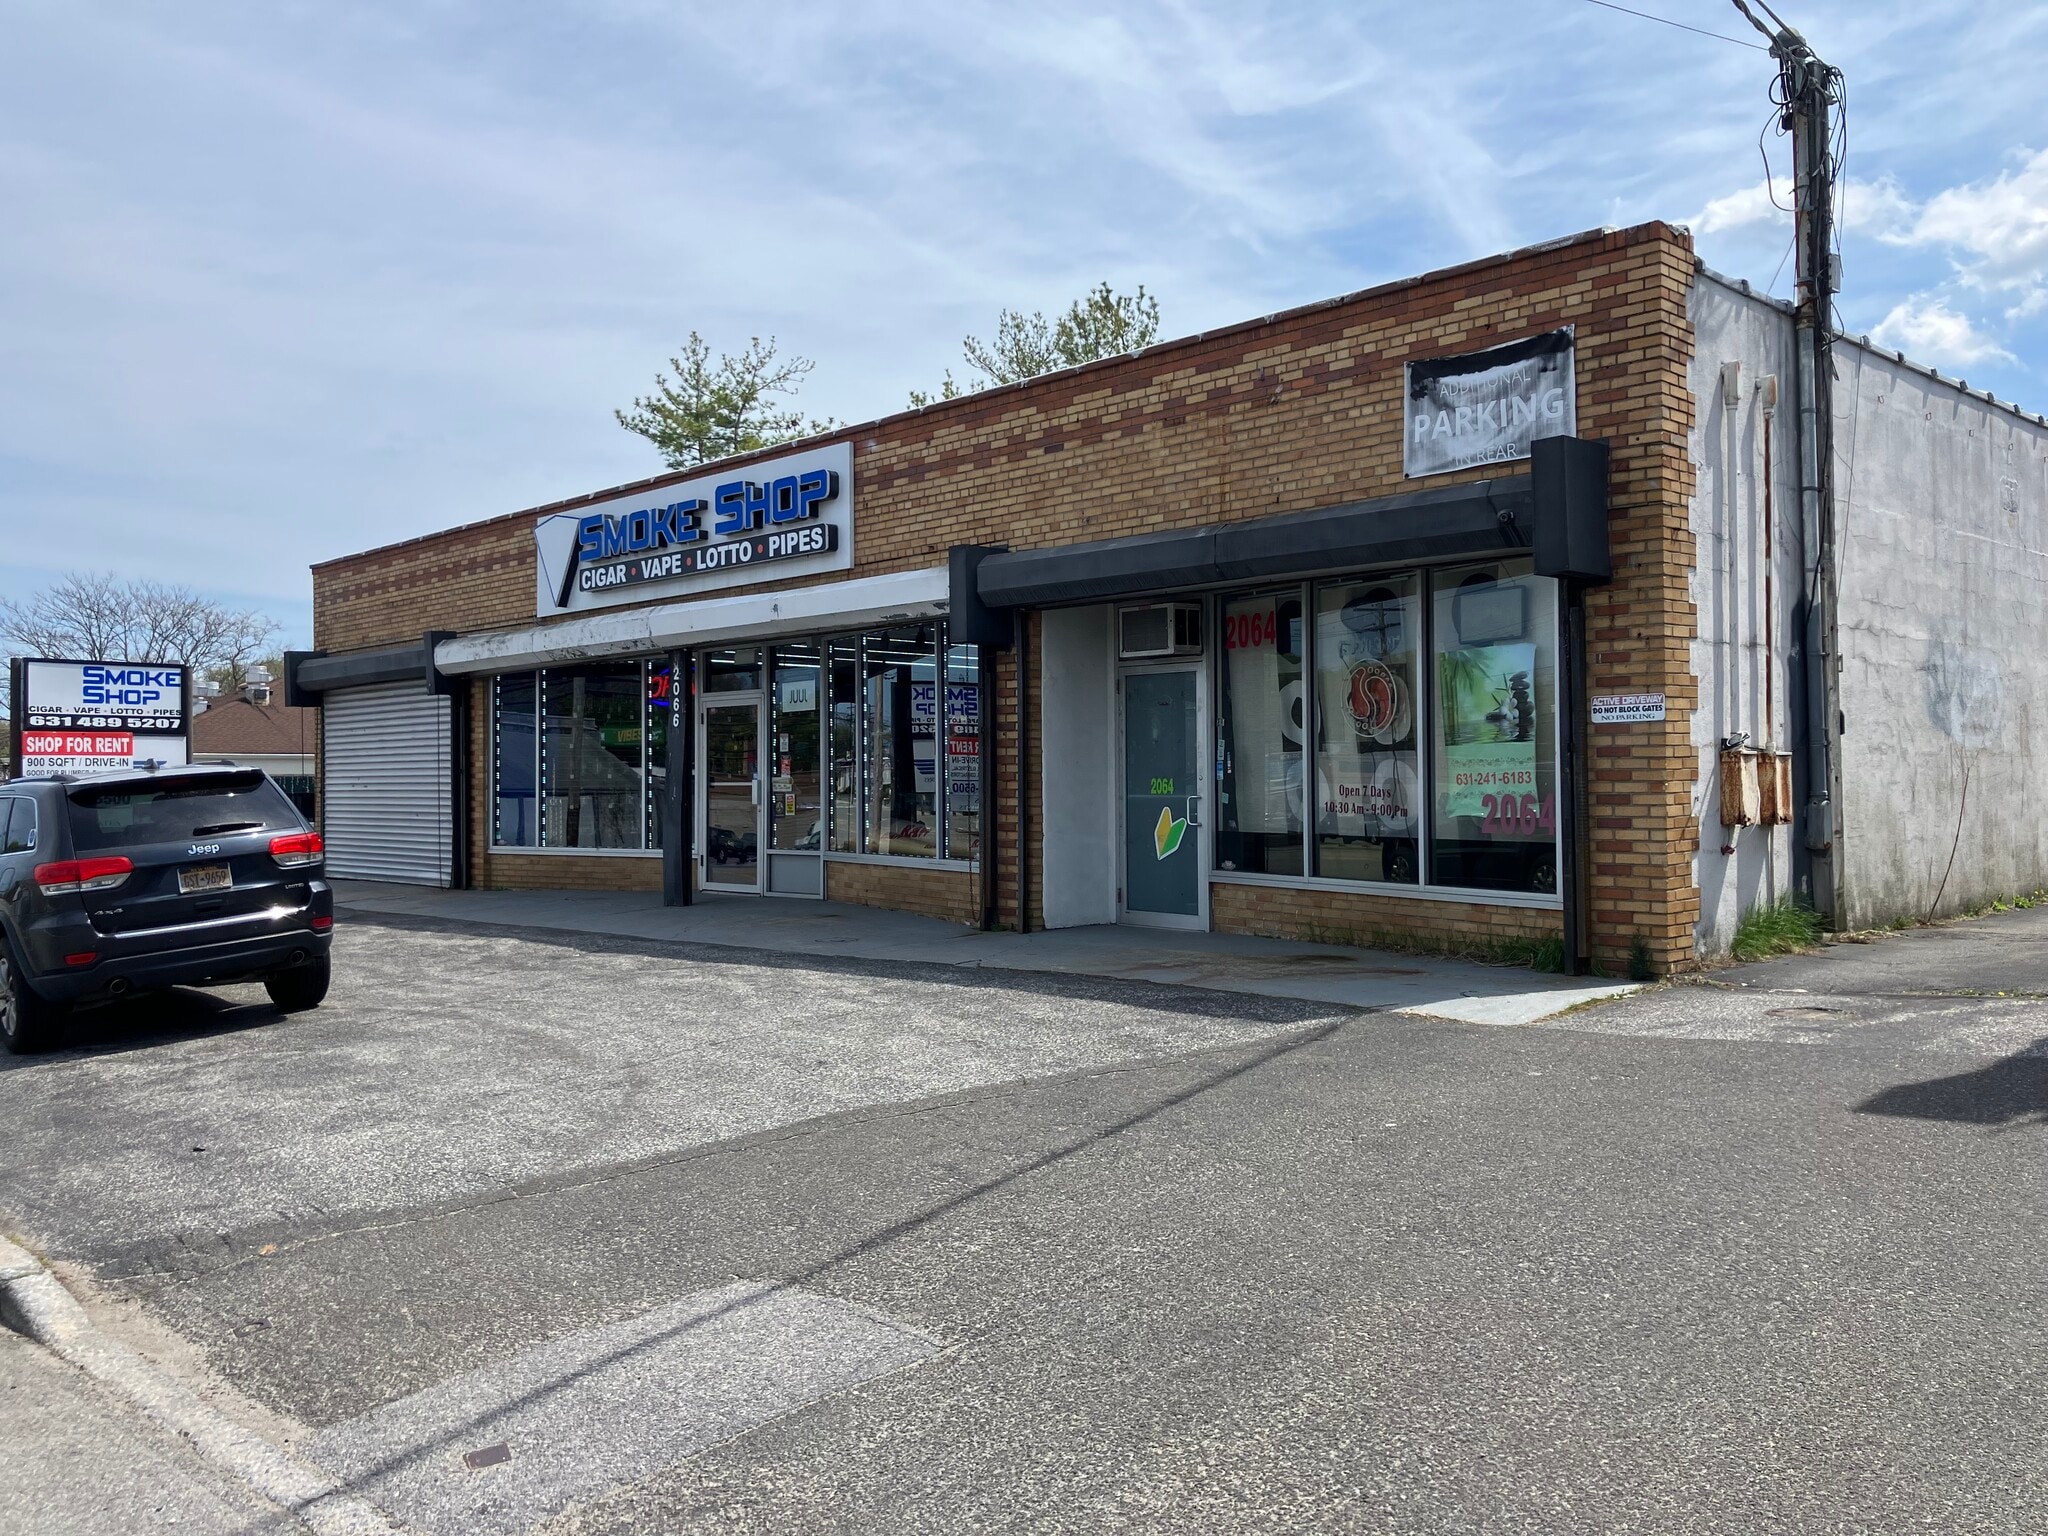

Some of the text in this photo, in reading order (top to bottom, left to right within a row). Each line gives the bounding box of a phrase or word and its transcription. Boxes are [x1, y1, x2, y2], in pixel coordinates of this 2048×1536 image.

[1439, 367, 1531, 398] ADDITIONAL
[1414, 387, 1564, 443] PARKING
[1455, 443, 1517, 467] IN REAR
[578, 468, 836, 562] SMOKE SHOP
[582, 526, 824, 590] CIGAR VAPE LOTTO PIPES
[1226, 610, 1276, 650] 2064
[83, 666, 181, 688] SMOKE
[83, 686, 160, 705] SHOP
[790, 689, 807, 704] JUUL
[1592, 695, 1663, 706] ACTIVE DRIVEWAY
[28, 705, 62, 713] CIGAR
[1620, 705, 1641, 713] BLOCK
[1642, 704, 1663, 712] GATES
[30, 716, 181, 729] 631 489 5207
[26, 736, 130, 753] SHOP FOR RENT
[27, 758, 45, 767] 900
[48, 758, 76, 768] SQFT
[85, 758, 129, 767] DRIVE-IN
[1151, 777, 1174, 795] 2064
[1456, 771, 1532, 786] 631-241-6183
[1339, 784, 1391, 800] Open 7 Days
[1325, 801, 1349, 813] 10:30
[1351, 802, 1364, 814] Am
[1371, 803, 1392, 816] 9:00
[1394, 804, 1408, 817] Pm
[1481, 793, 1556, 836] 2064
[188, 843, 220, 855] Jeep
